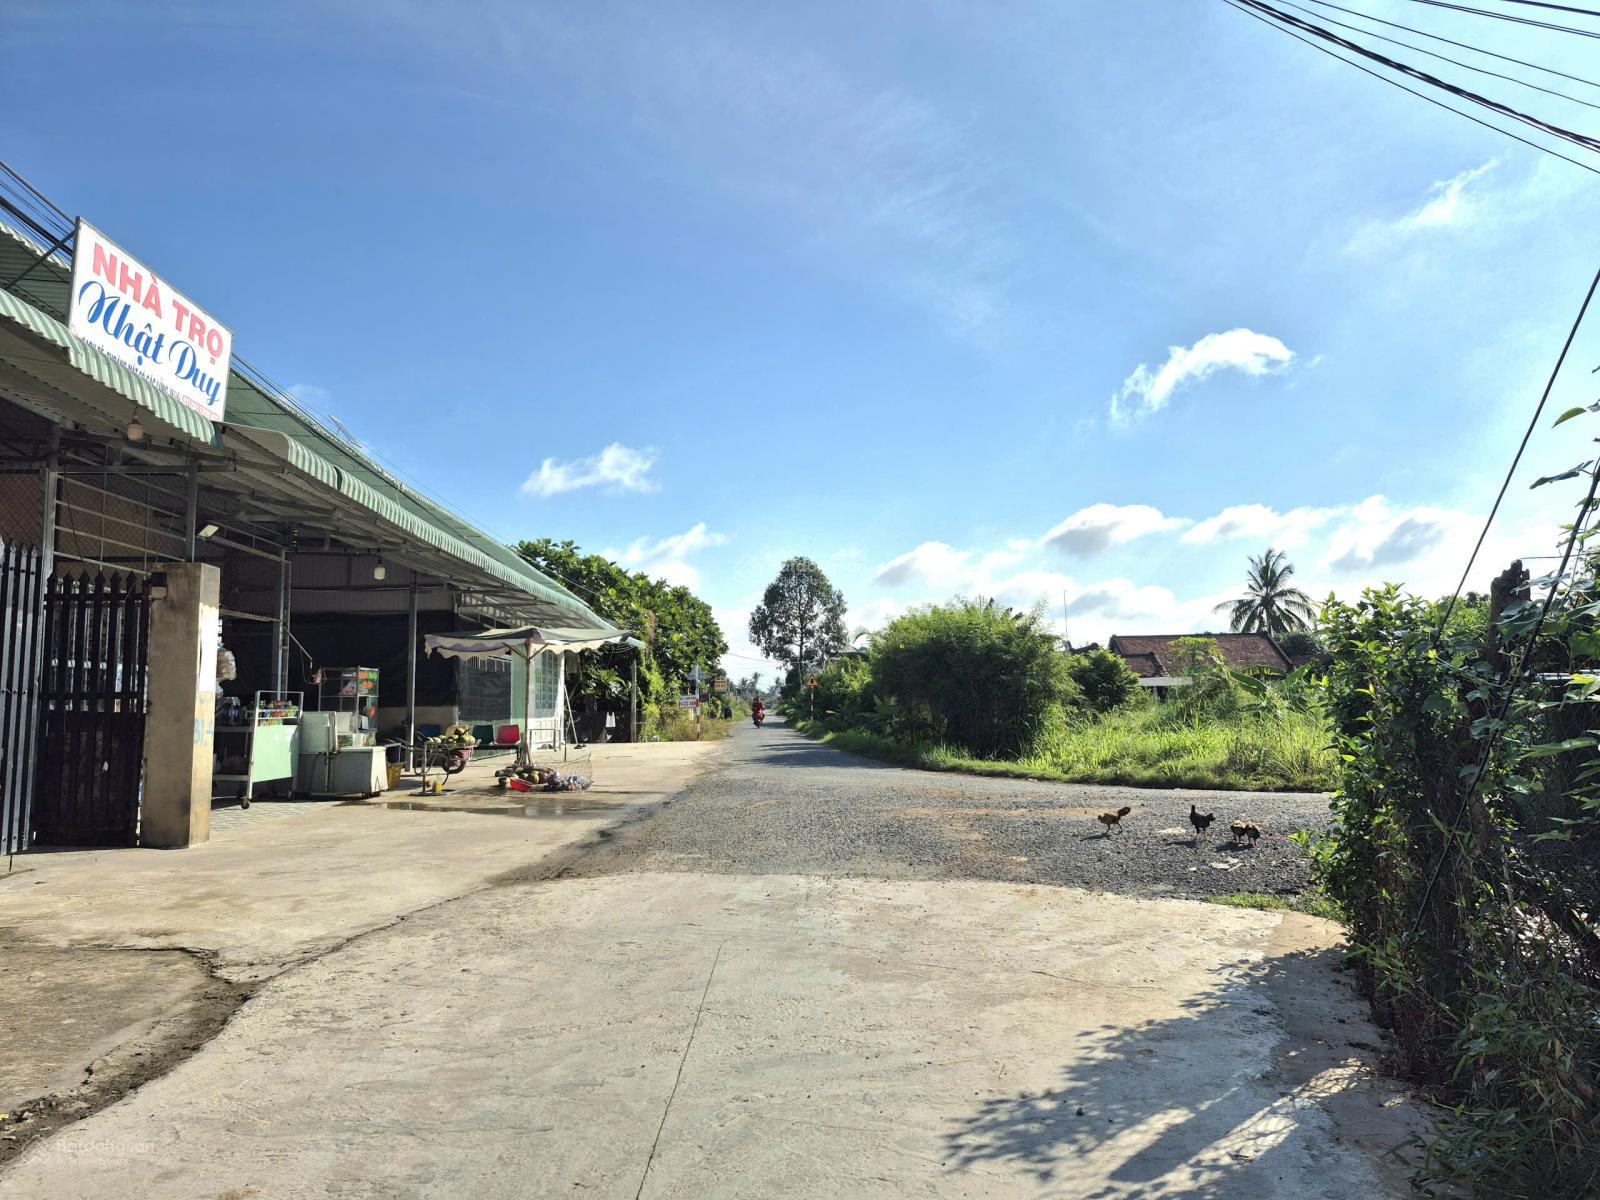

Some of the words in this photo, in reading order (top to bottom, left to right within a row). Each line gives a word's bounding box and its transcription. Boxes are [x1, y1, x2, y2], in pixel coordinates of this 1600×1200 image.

[79, 280, 163, 365] Nhật
[169, 340, 220, 405] Duy
[93, 242, 162, 319] NHÀ
[172, 299, 223, 364] TRỌ
